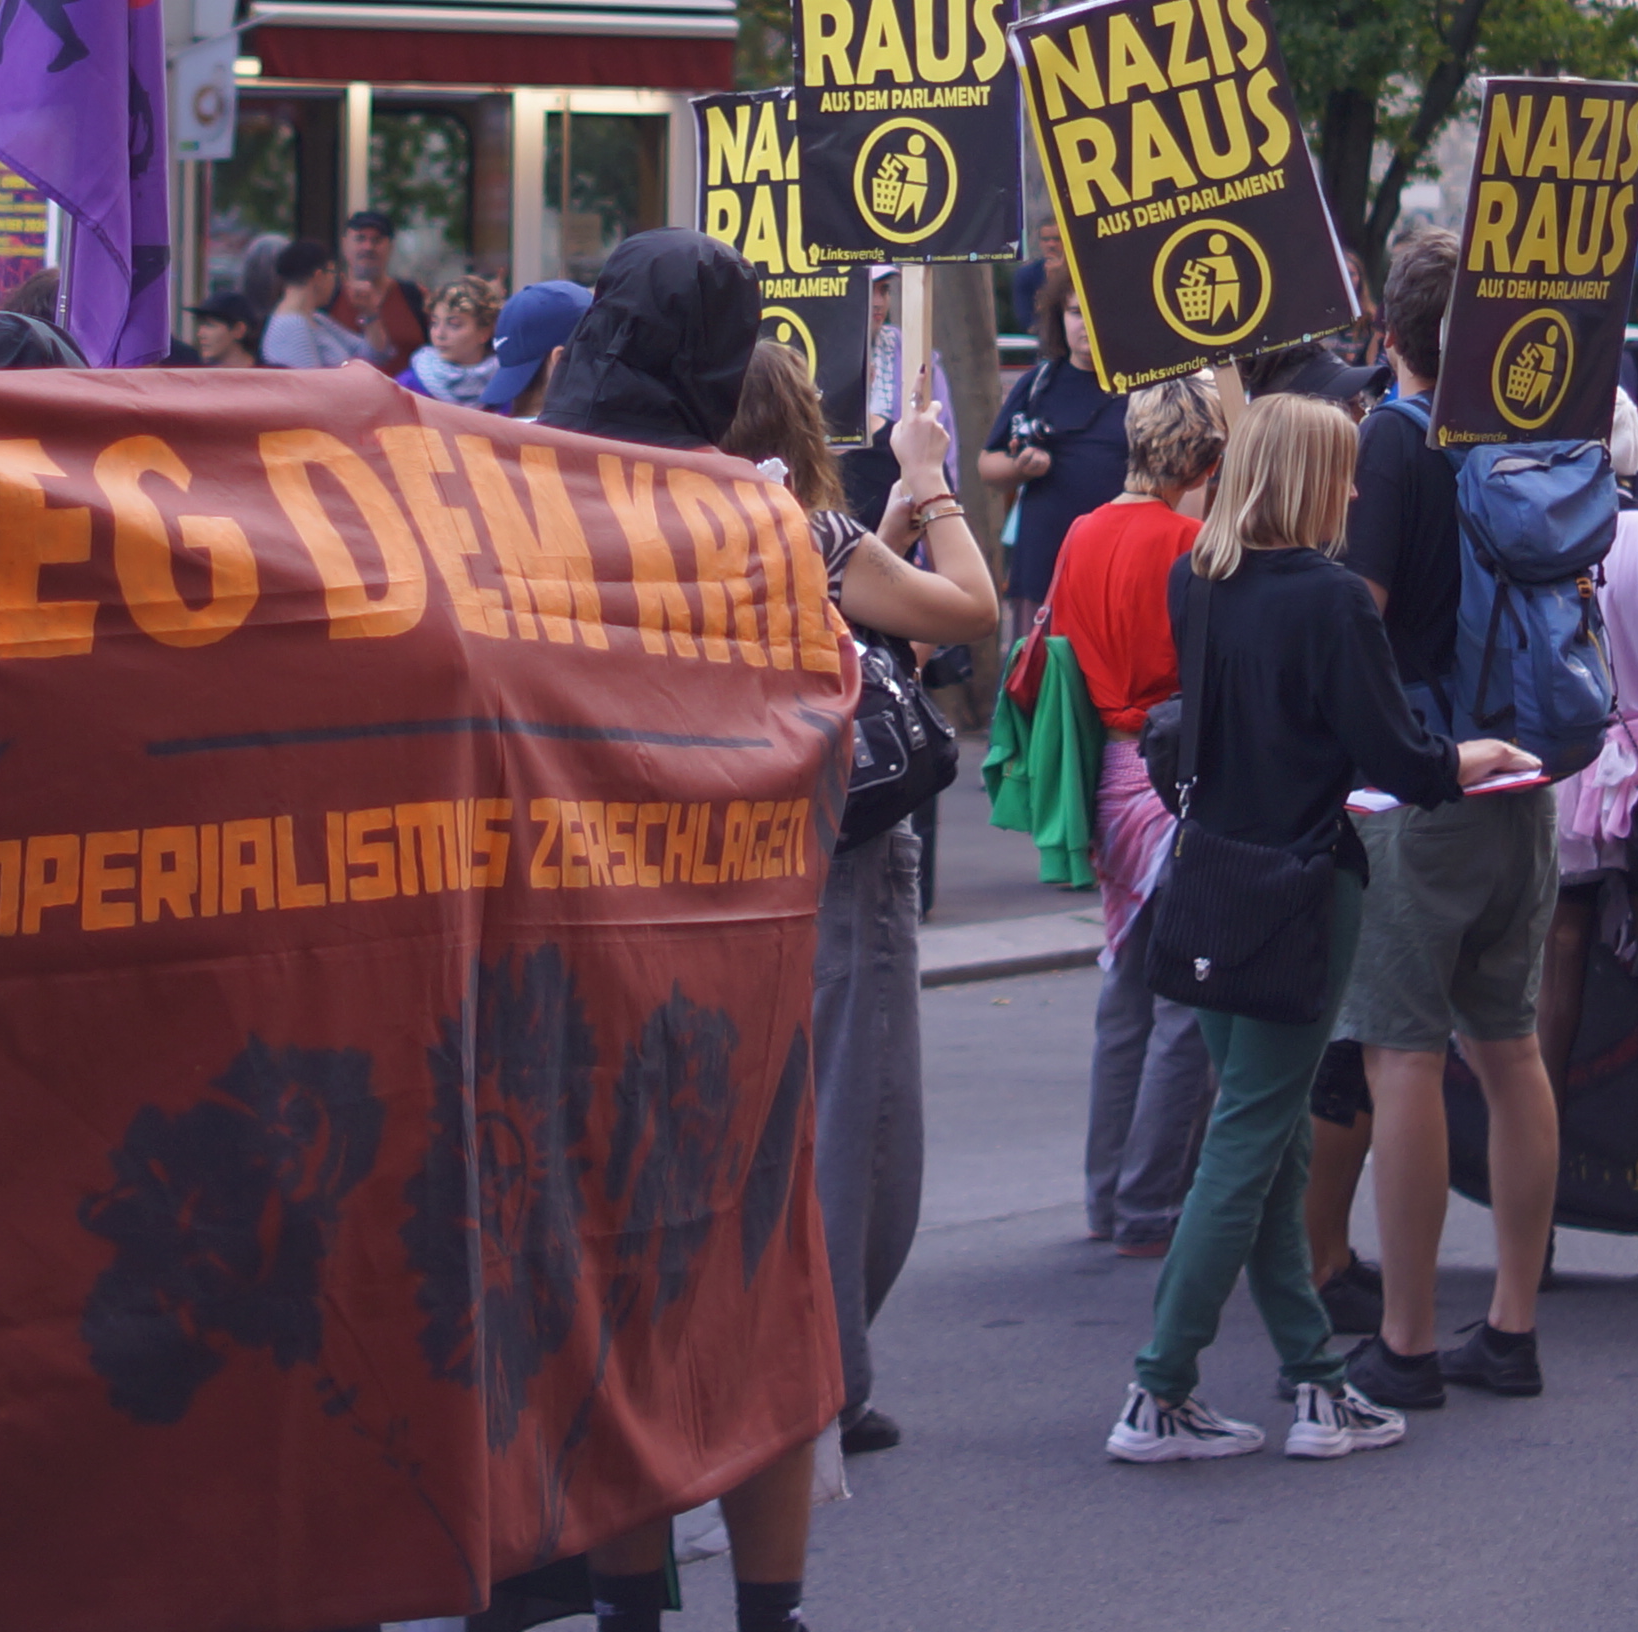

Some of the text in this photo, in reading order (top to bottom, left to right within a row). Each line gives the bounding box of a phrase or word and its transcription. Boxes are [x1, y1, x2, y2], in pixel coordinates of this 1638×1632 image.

[820, 85, 991, 113] AUS DEM PARLAMENT
[1052, 67, 1291, 217] RAUS
[707, 184, 851, 274] RAU
[1097, 169, 1285, 238] AUS DEM PARLAMENT
[1467, 180, 1634, 277] RAUS
[764, 277, 849, 299] PARLAMENT
[820, 247, 885, 262] Linkswende
[1477, 278, 1610, 300] AUS DEM PARLAMENT
[1128, 355, 1208, 388] Linkswende
[259, 425, 609, 651] DEM
[529, 796, 809, 888] ZERSCHLAGEN
